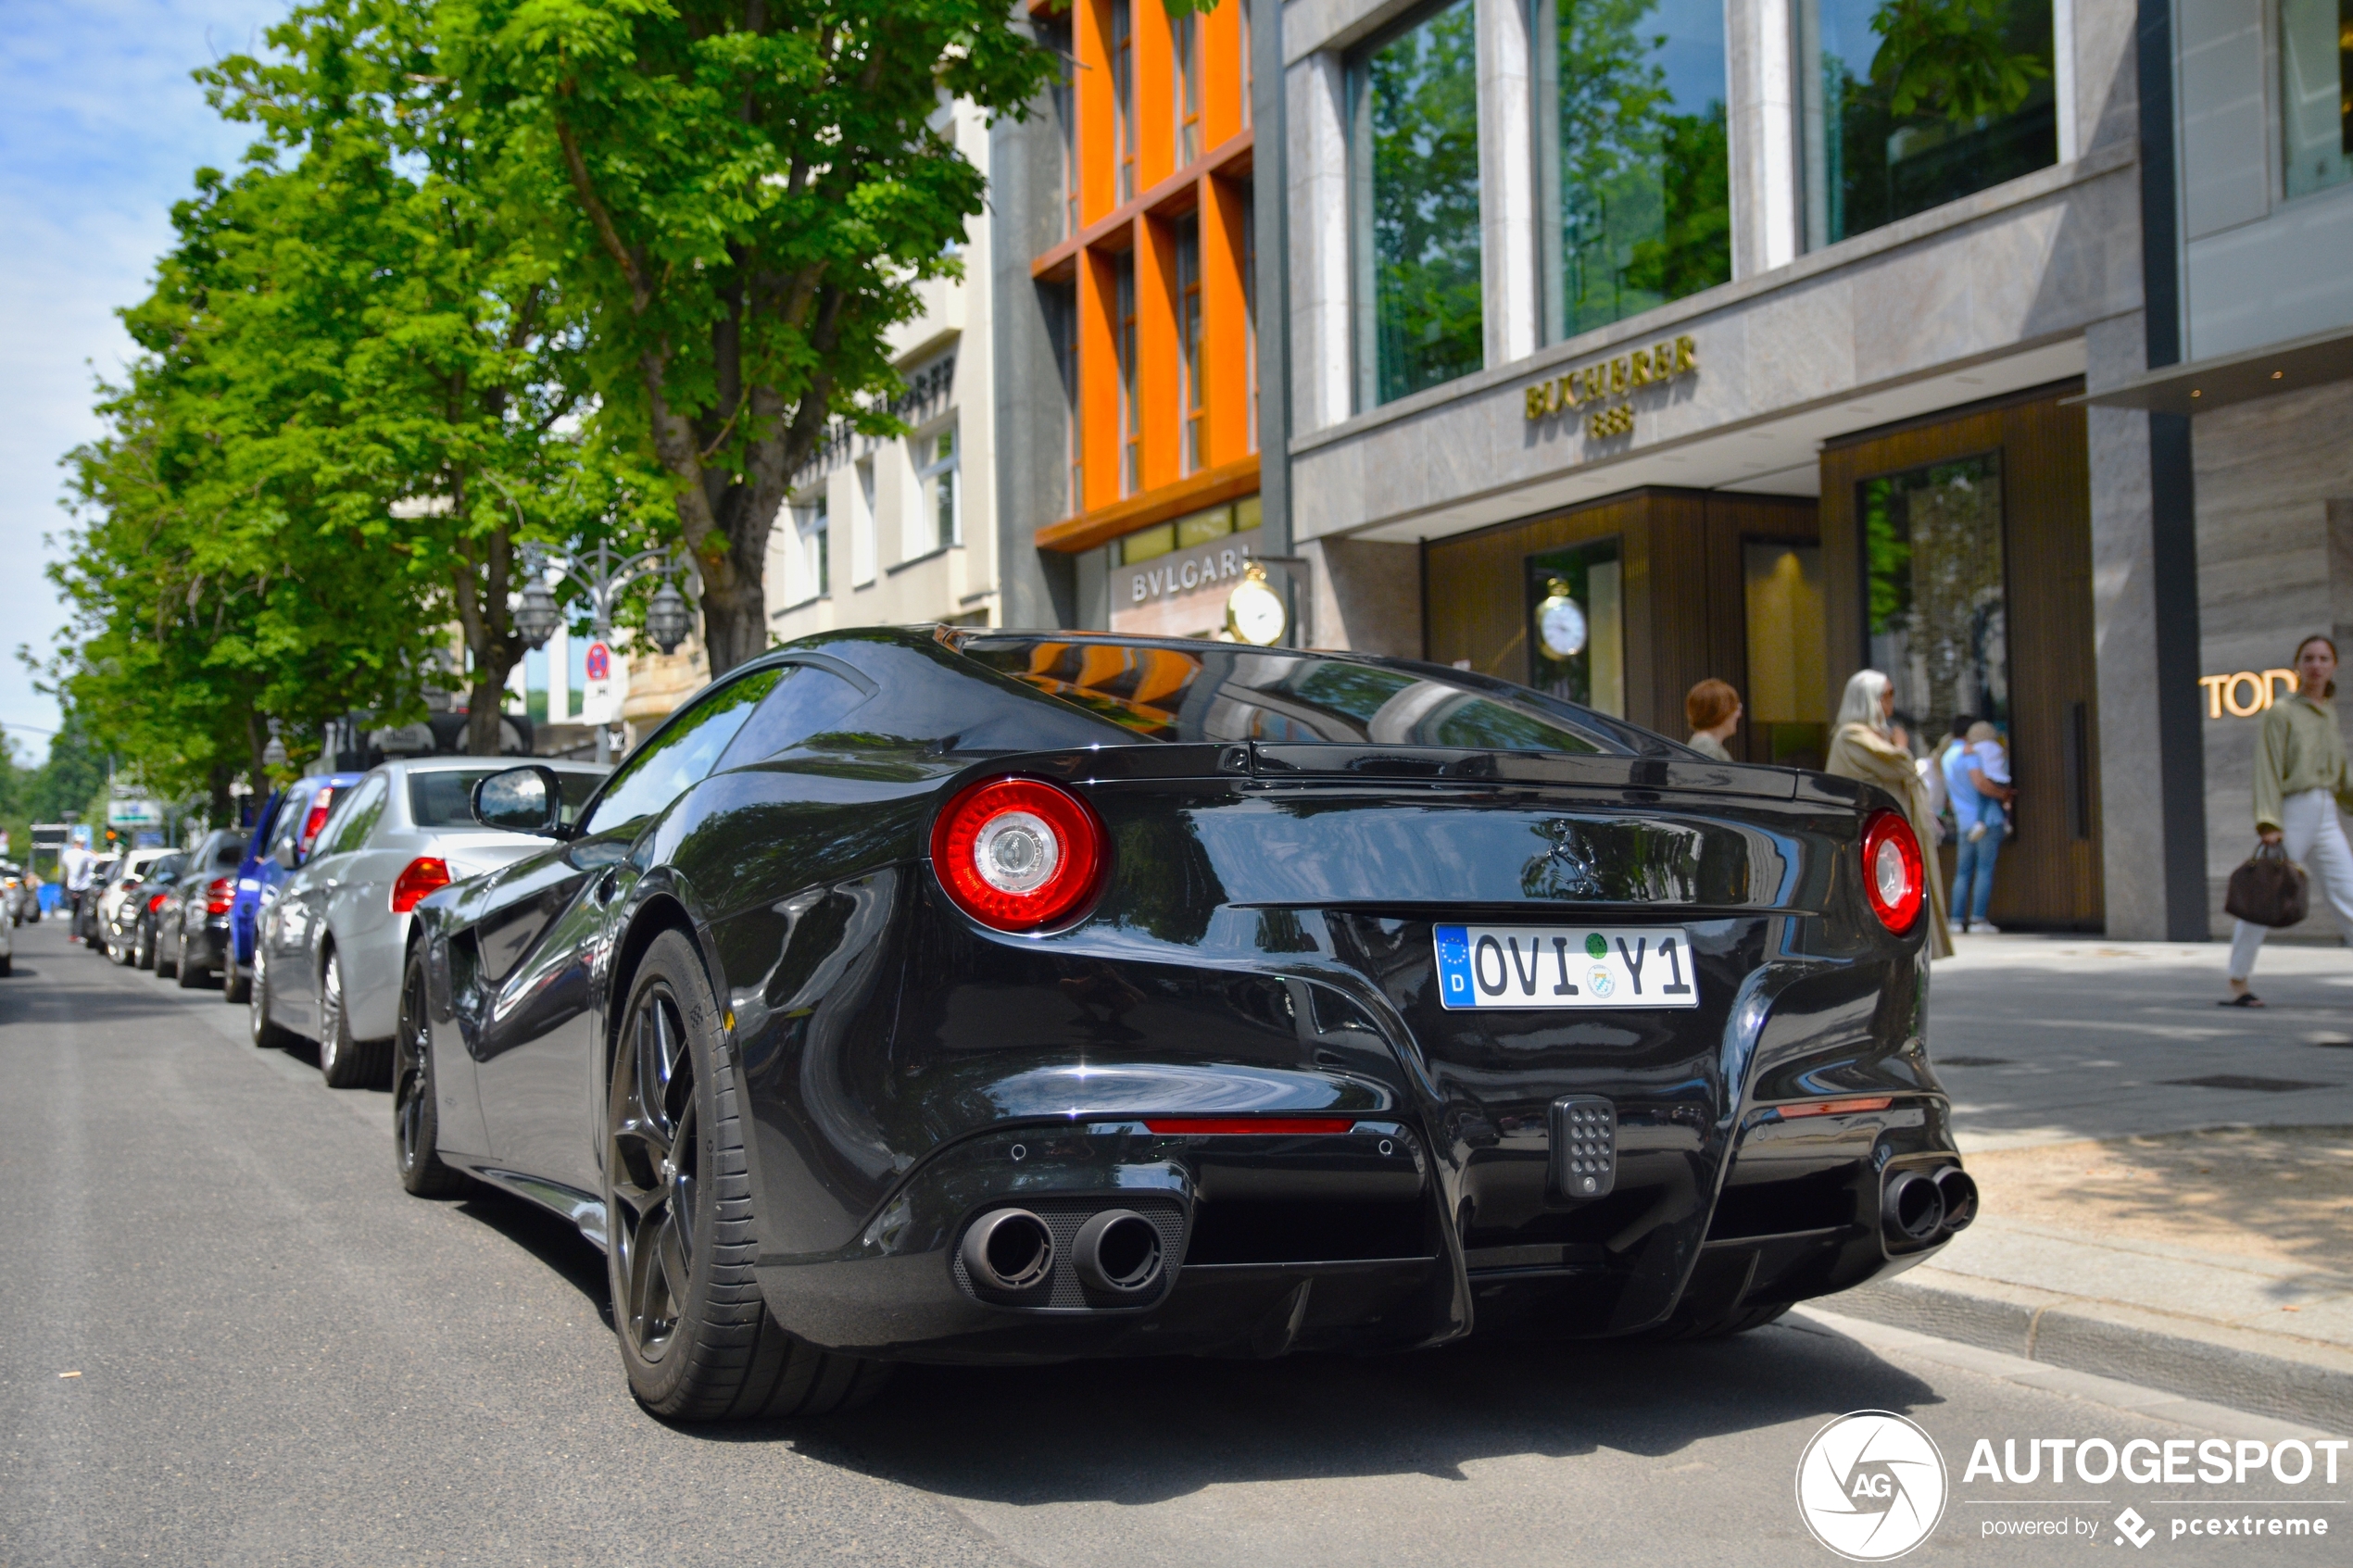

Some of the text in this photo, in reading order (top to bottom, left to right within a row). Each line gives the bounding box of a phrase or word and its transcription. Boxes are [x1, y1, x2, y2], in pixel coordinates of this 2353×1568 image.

[1525, 334, 1697, 420] BUCHERER
[1451, 974, 1465, 992] D
[1474, 934, 1579, 997] OVI
[1616, 936, 1692, 995] Y1
